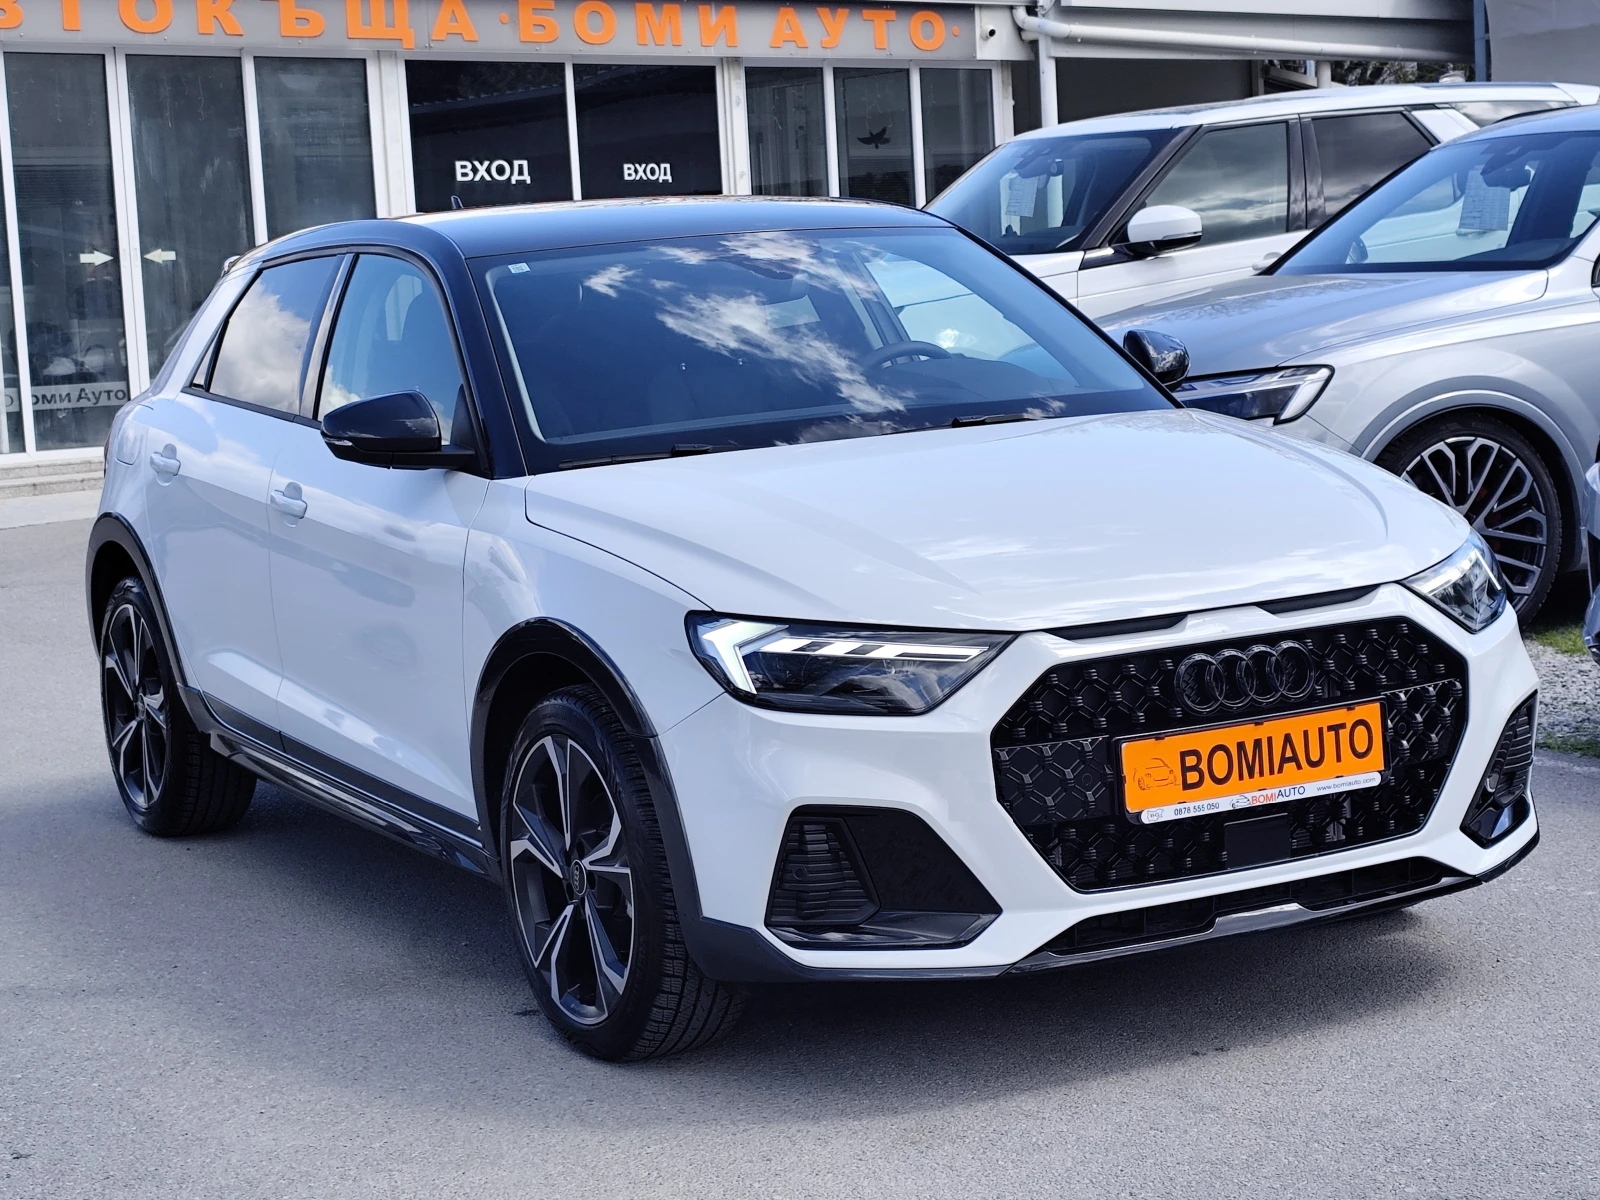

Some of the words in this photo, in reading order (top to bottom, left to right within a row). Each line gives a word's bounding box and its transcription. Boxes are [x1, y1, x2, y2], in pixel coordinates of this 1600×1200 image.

[518, 0, 738, 47] БОМИ
[769, 7, 946, 51] АУТО
[455, 160, 531, 184] ВХОД
[623, 163, 673, 183] ВХОД
[32, 392, 71, 406] оми
[76, 388, 127, 405] Ауто
[1179, 718, 1374, 791] BOMIAUTO
[1316, 777, 1376, 792] www.bomiauto.com
[1251, 786, 1306, 805] BOMIAUTO
[1174, 807, 1191, 816] 0878
[1193, 805, 1205, 813] 555
[1206, 802, 1220, 810] 050
